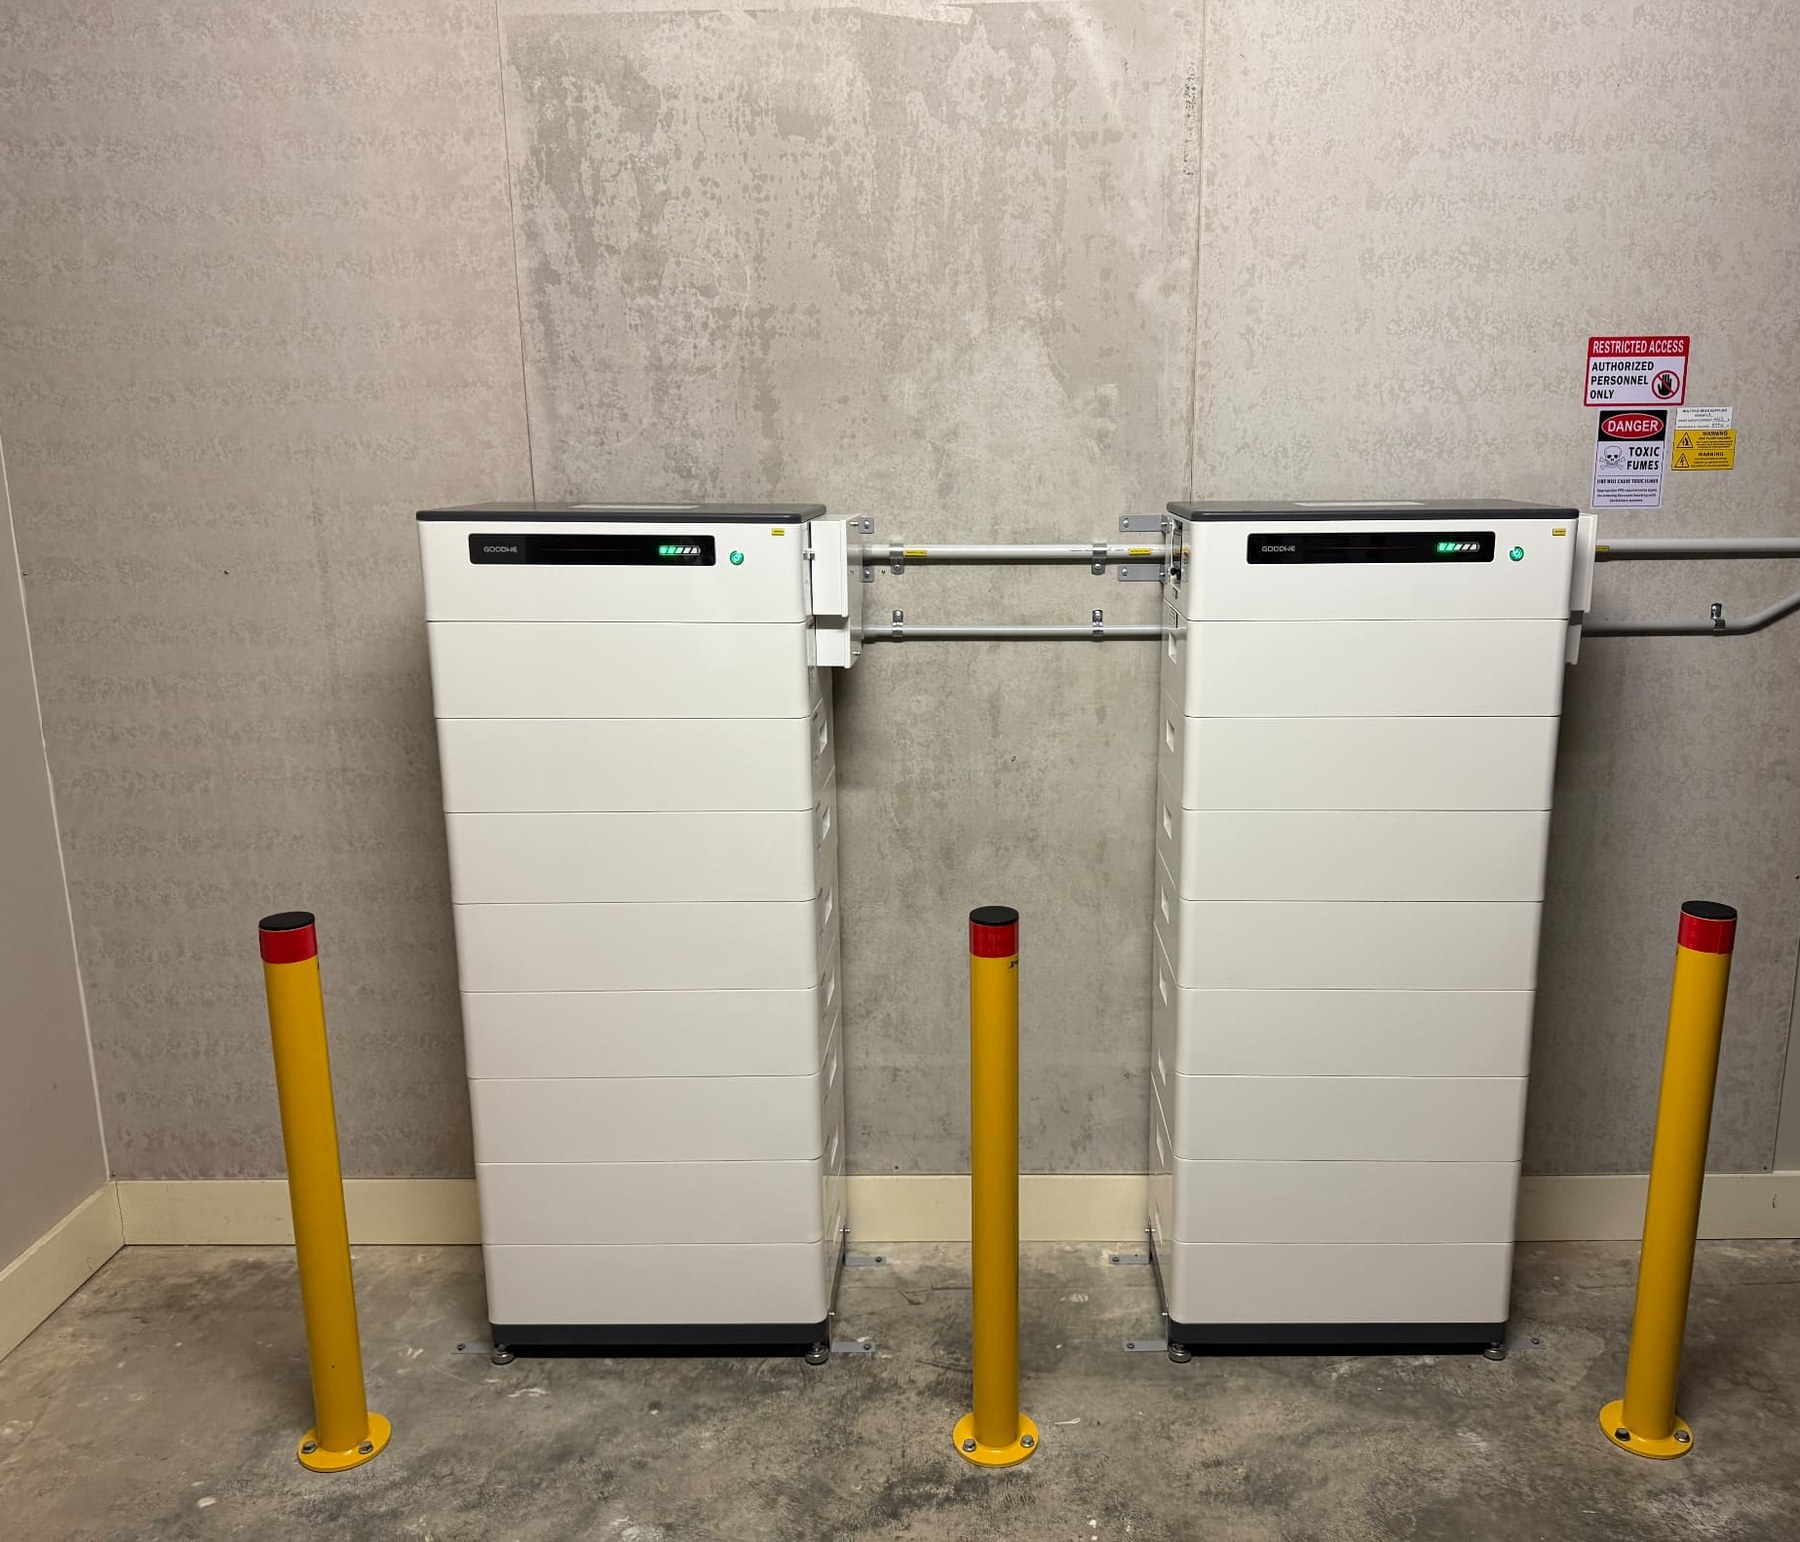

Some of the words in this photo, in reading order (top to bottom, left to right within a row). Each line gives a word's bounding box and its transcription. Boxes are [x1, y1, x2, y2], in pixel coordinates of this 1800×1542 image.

[1593, 340, 1647, 354] RESTRICTED
[1649, 340, 1684, 353] ACCESS
[1591, 361, 1654, 371] AUTHORIZED
[1591, 375, 1649, 385] PERSONNEL
[1590, 389, 1614, 399] ONLY
[1607, 420, 1659, 433] DANGER
[1628, 446, 1660, 457] TOXIC
[1626, 460, 1659, 471] FUMES
